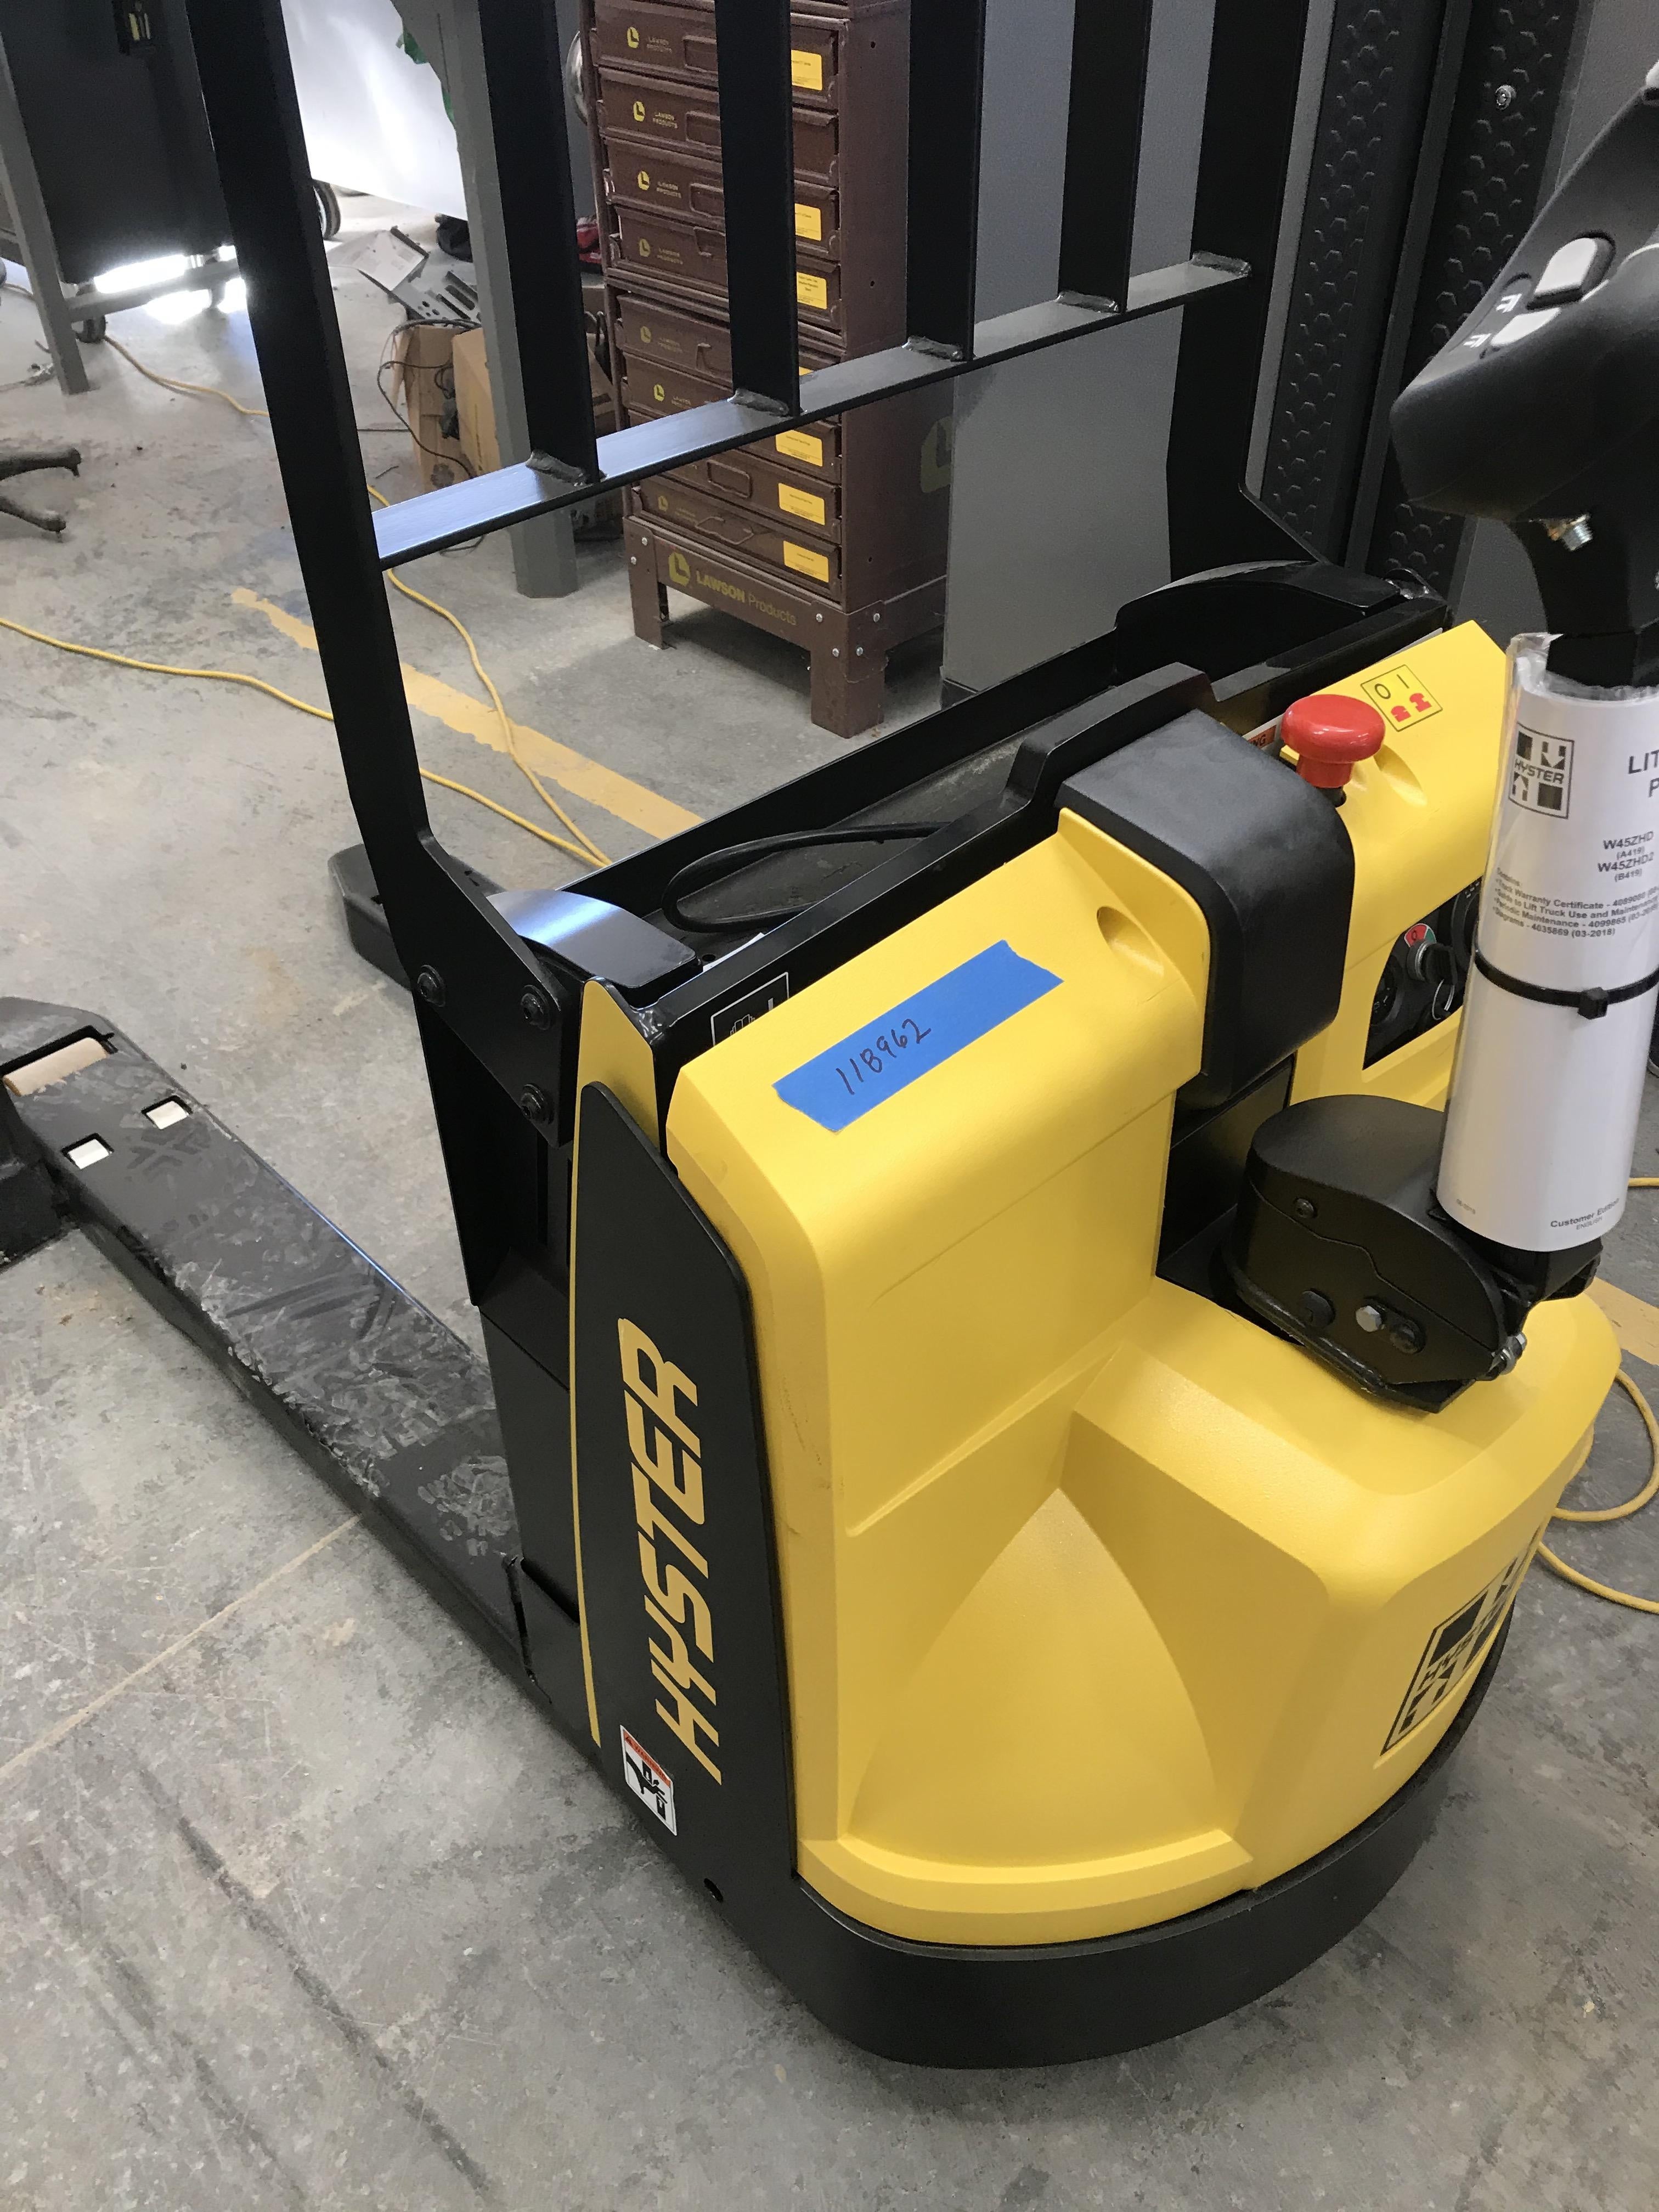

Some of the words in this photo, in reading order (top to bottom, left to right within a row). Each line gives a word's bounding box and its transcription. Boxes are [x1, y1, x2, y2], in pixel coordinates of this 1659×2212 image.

[696, 570, 746, 603] LAWSON
[747, 591, 797, 625] Products
[1514, 759, 1564, 785] HYSTER
[1602, 831, 1654, 850] W45ZHD
[1515, 889, 1551, 906] Warranty
[1554, 899, 1604, 909] Certificate
[1523, 901, 1537, 912] Lift
[1540, 906, 1565, 917] Truck
[1522, 910, 1579, 928] Maintenance
[836, 1019, 932, 1095] 118962
[1550, 1212, 1595, 1228] Customer
[618, 1318, 722, 1785] HYSTER
